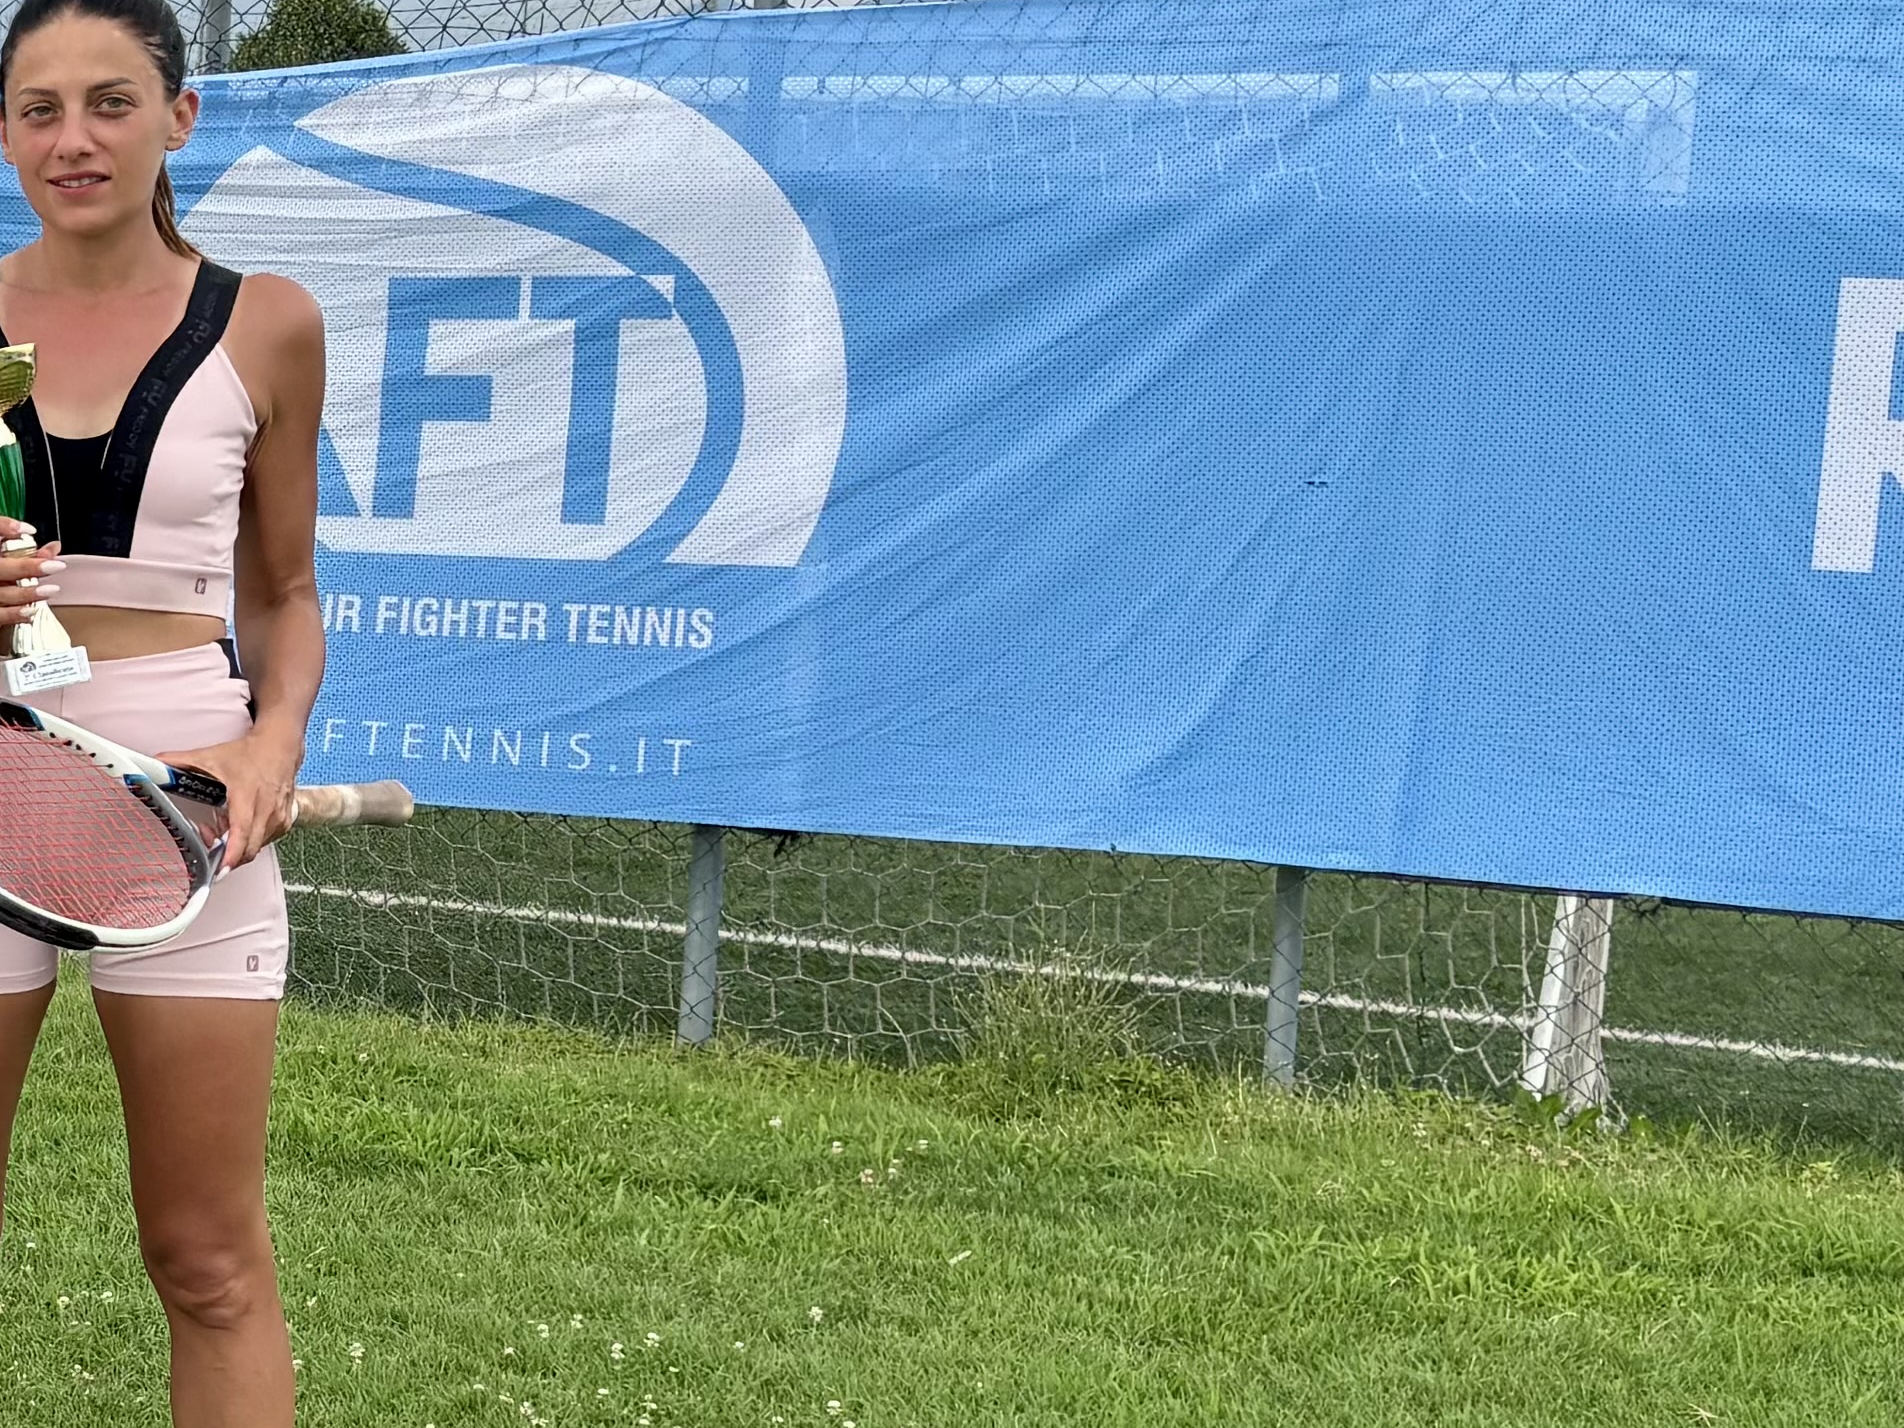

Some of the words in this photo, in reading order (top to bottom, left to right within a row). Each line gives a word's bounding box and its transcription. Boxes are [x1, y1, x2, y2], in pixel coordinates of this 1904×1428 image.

[317, 274, 675, 526] FT
[375, 596, 548, 642] FIGHTER
[563, 603, 714, 649] TENNIS
[322, 718, 692, 776] FTENNIS.IT
